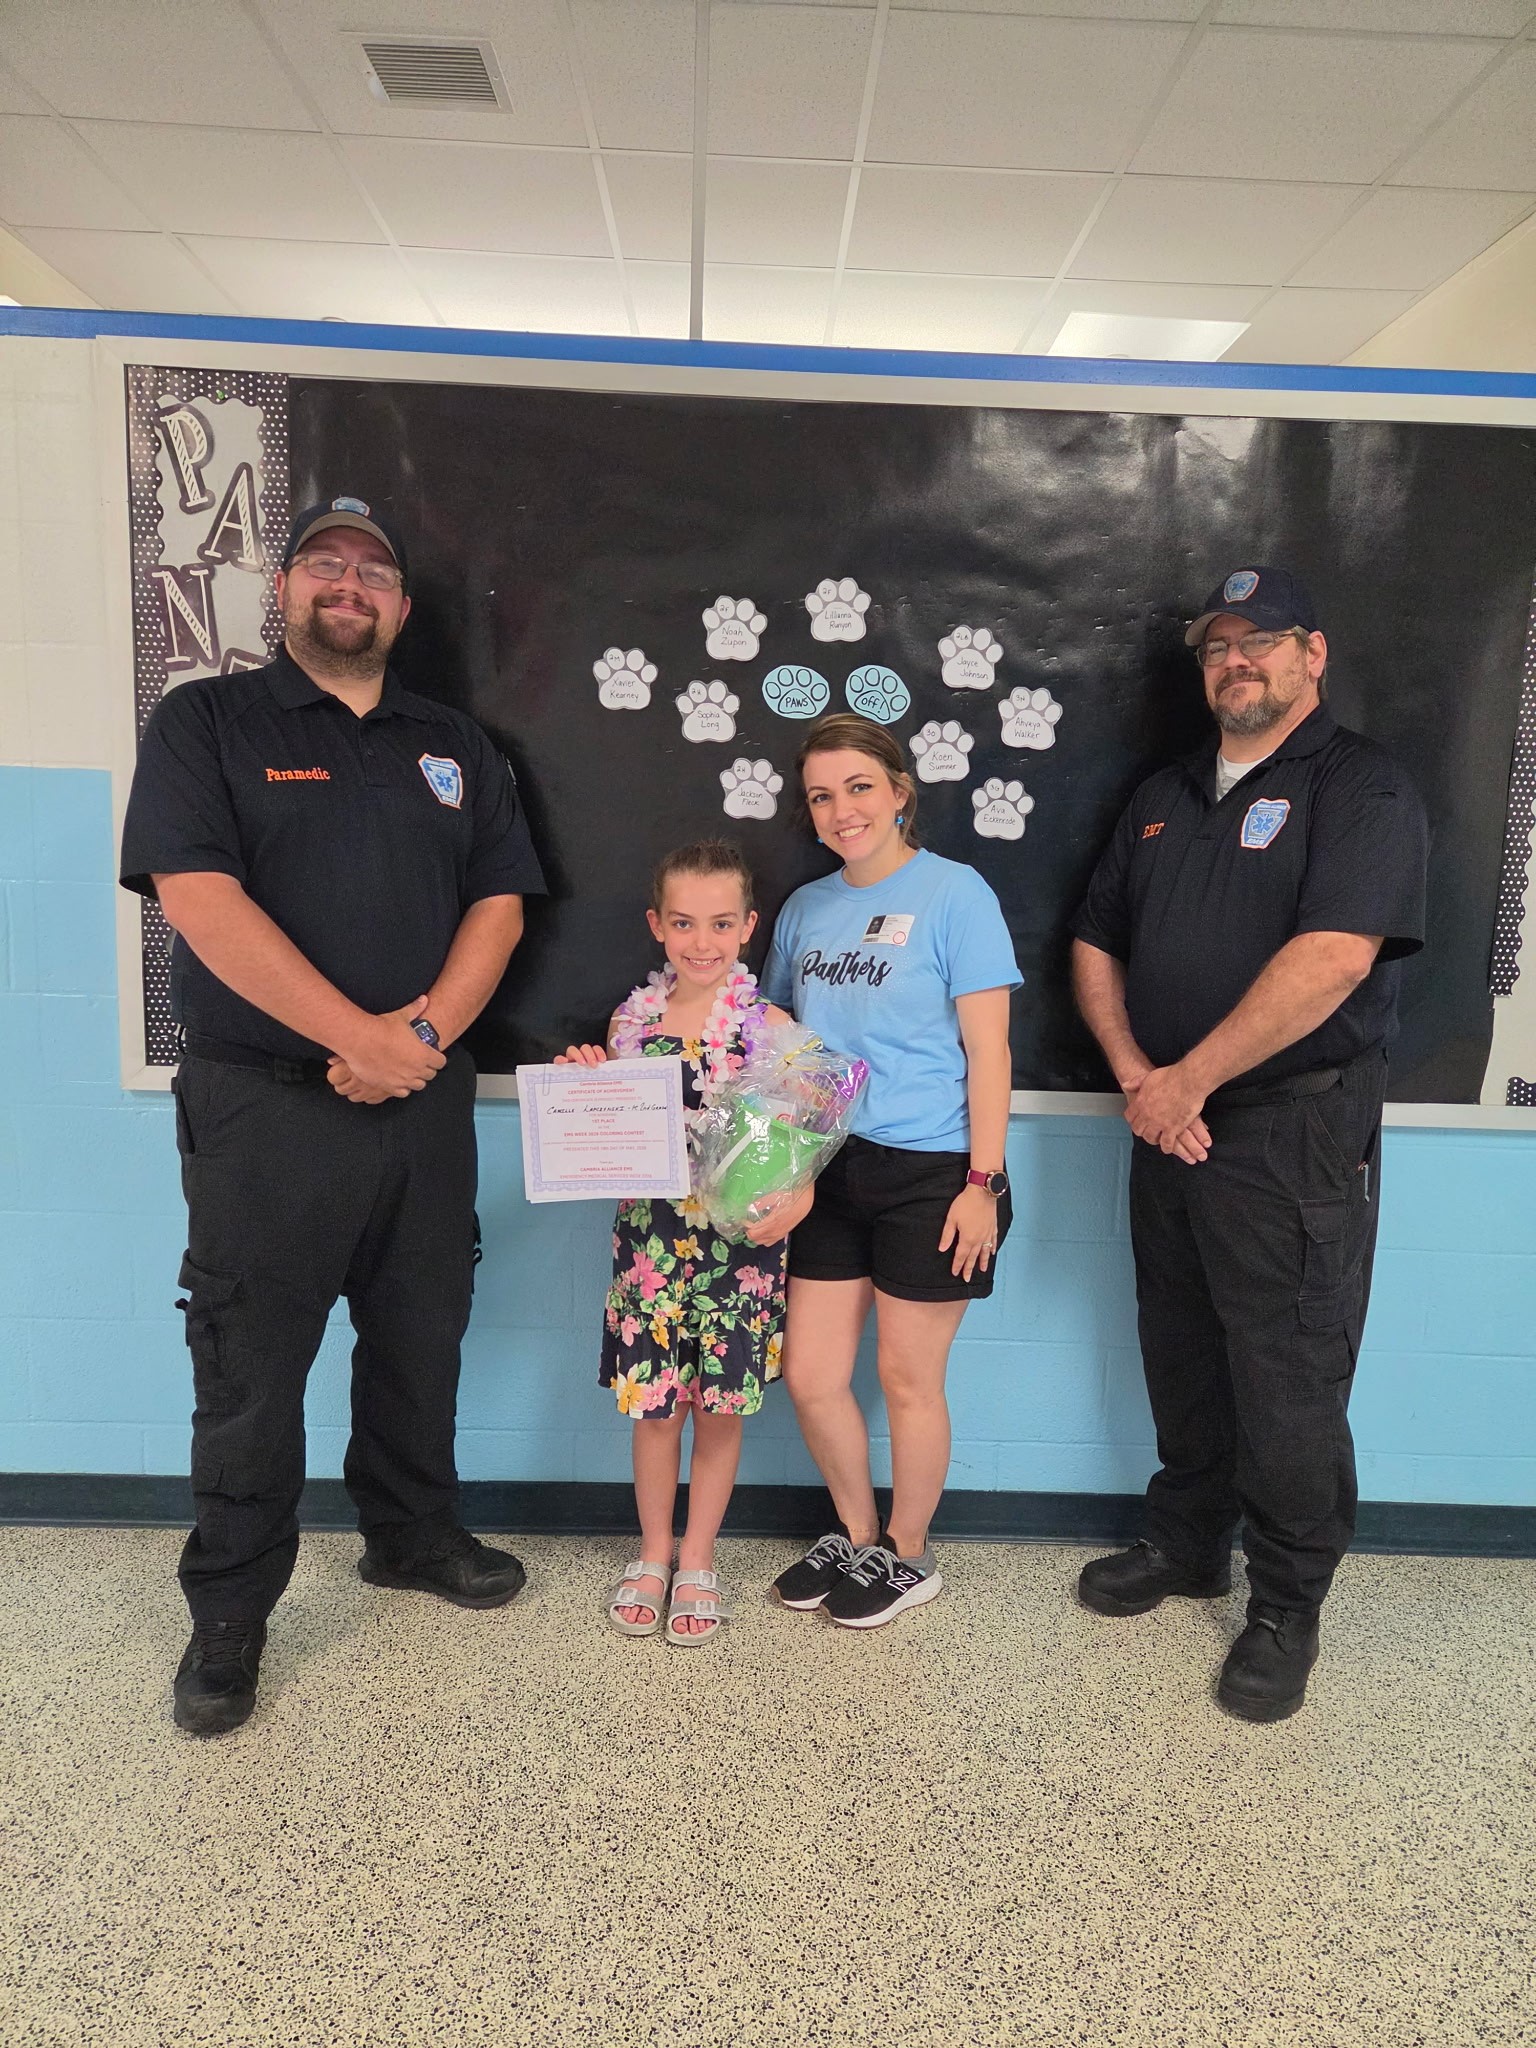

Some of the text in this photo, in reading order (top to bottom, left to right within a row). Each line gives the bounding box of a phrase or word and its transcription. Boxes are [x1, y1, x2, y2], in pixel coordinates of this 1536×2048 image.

[722, 625, 743, 636] Noah
[720, 636, 747, 648] Zupon
[957, 656, 978, 669] Jayce
[960, 669, 989, 680] Johnson
[611, 677, 635, 688] Xavier
[609, 690, 639, 703] Kearney
[785, 696, 809, 708] PAWS
[697, 710, 720, 720] Sophia
[701, 721, 719, 731] Long
[1014, 729, 1040, 739] Walker
[931, 751, 953, 761] Koen
[265, 767, 331, 782] Paramedic
[738, 787, 763, 799] Jackson
[990, 804, 1006, 814] Ava
[1142, 822, 1165, 839] EMT
[801, 949, 893, 987] Panthers
